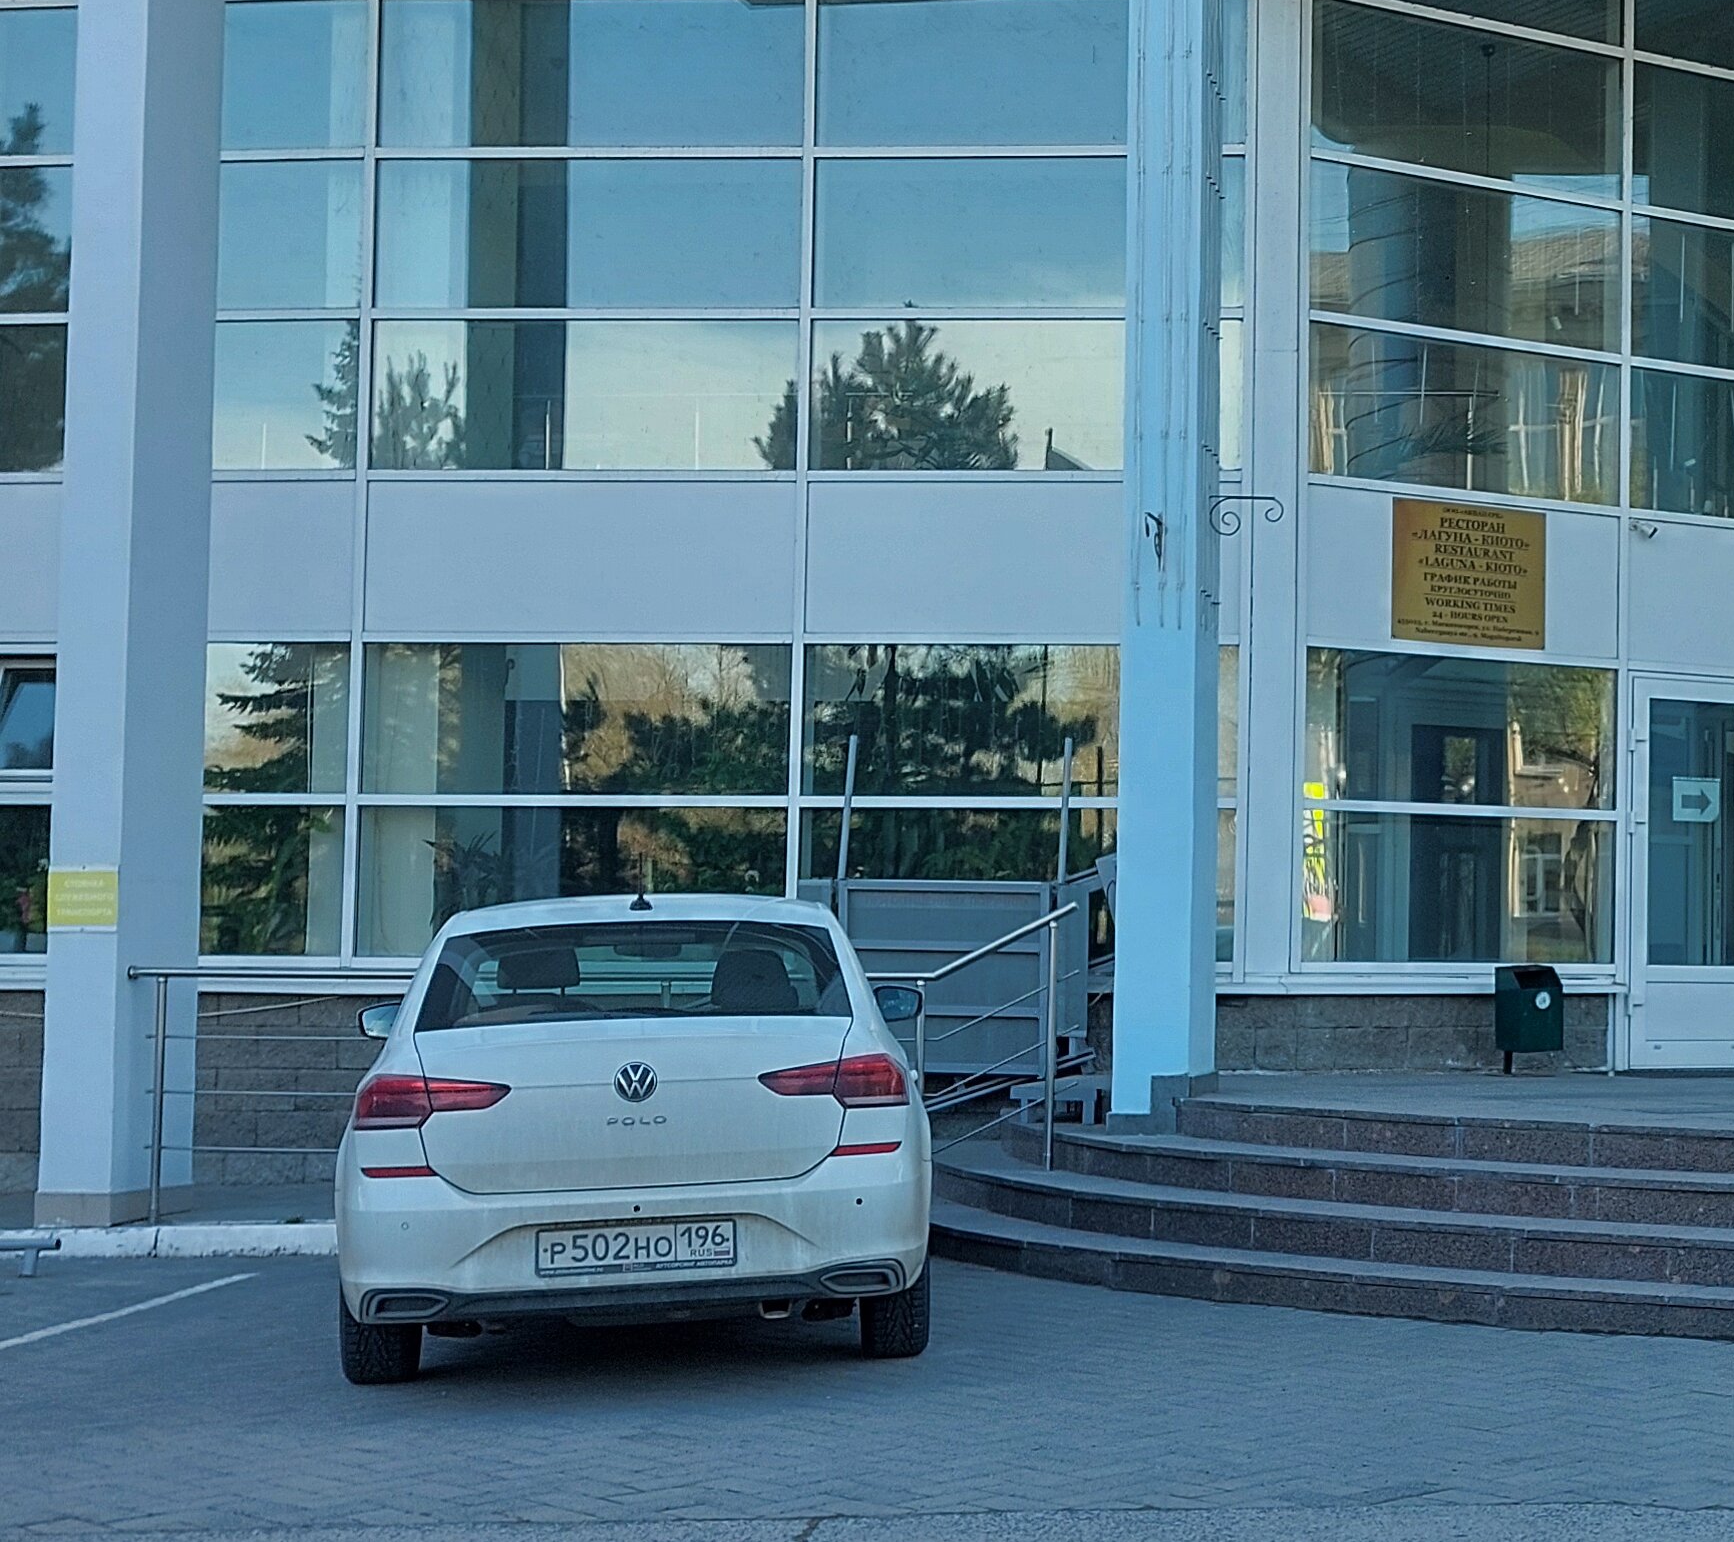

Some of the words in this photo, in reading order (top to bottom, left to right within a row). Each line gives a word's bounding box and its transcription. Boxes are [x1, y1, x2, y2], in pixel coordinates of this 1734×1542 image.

[1439, 516, 1505, 534] РЕСТОРАН
[1434, 544, 1515, 561] RESTAURANT
[1423, 572, 1471, 585] ГРАФИК
[1473, 576, 1517, 590] РАБОТЫ
[1430, 584, 1511, 600] КРУГЛОСУТОЧНО
[1424, 596, 1480, 610] WORKING
[1482, 601, 1516, 614] TIMES
[1450, 611, 1482, 621] HOURS
[1484, 614, 1508, 624] OPEN
[606, 1115, 668, 1126] POLO
[680, 1225, 725, 1248] 196
[690, 1247, 713, 1257] RUS
